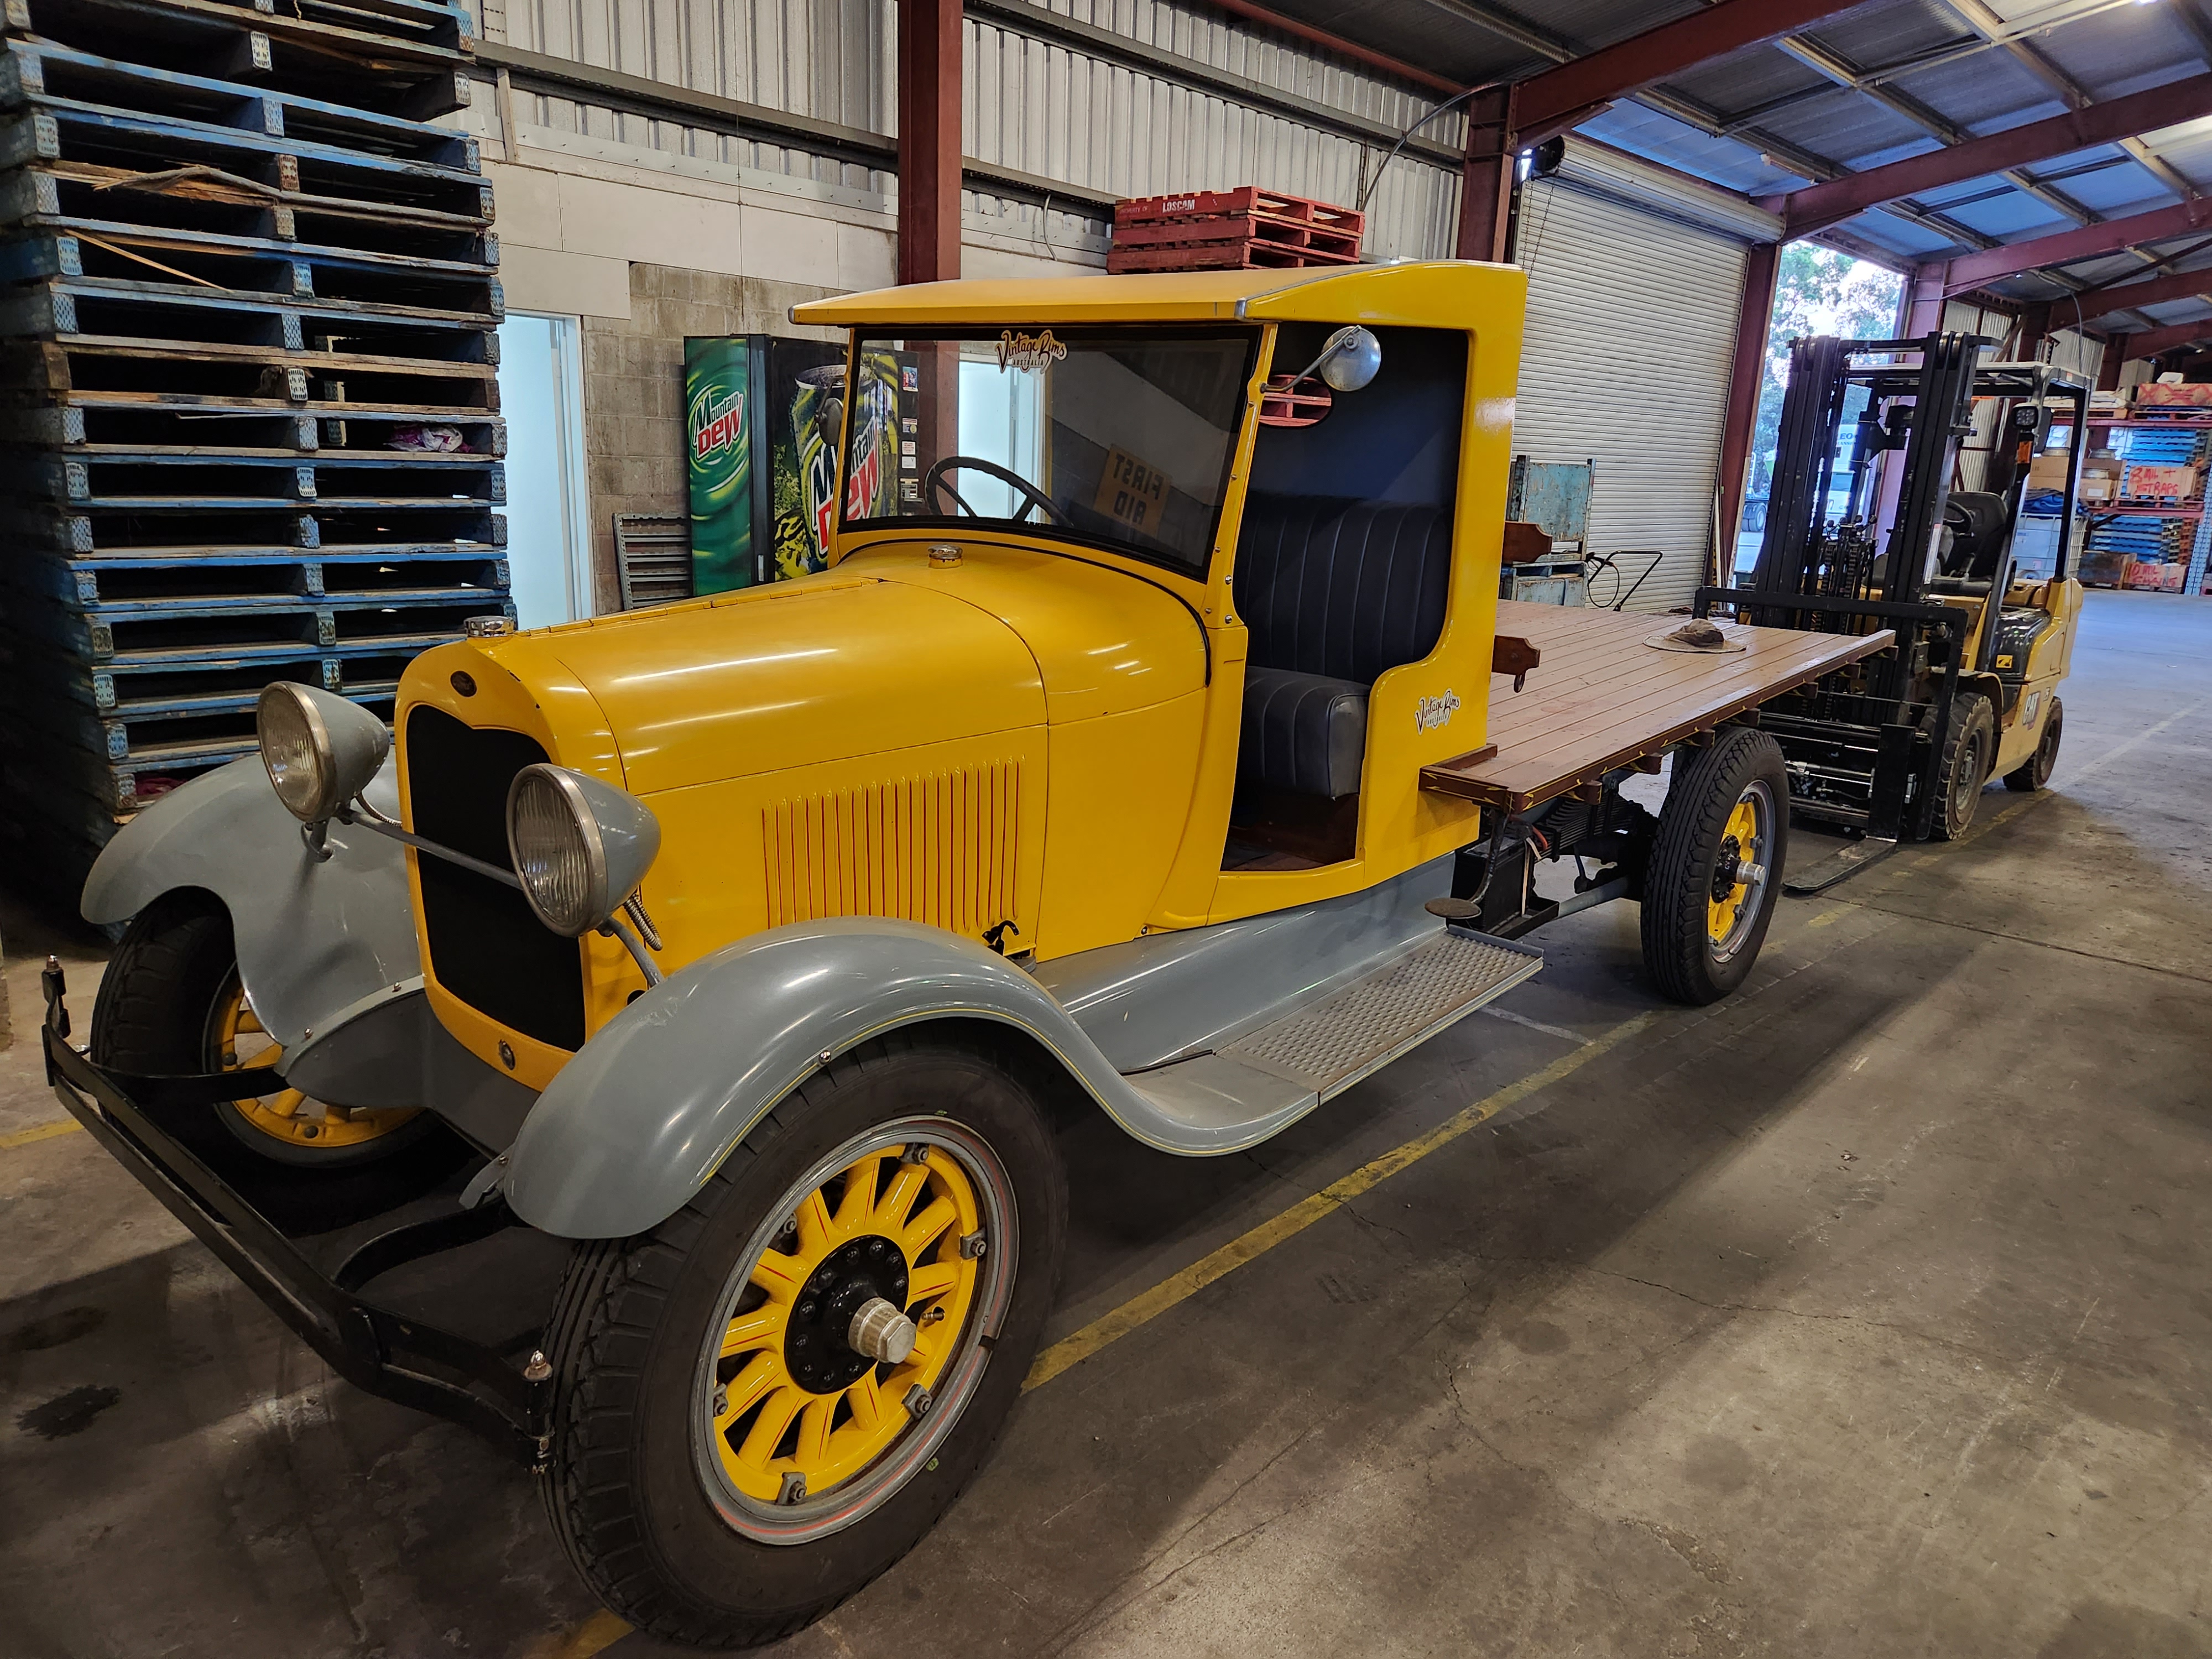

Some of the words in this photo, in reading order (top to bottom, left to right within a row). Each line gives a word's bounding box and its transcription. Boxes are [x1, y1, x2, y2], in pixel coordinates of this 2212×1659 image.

[1162, 199, 1195, 213] LOSCAM
[997, 333, 1038, 371] Vintage
[693, 392, 738, 444] Mountain
[1416, 698, 1442, 733] Vintage
[2023, 692, 2040, 725] CAT
